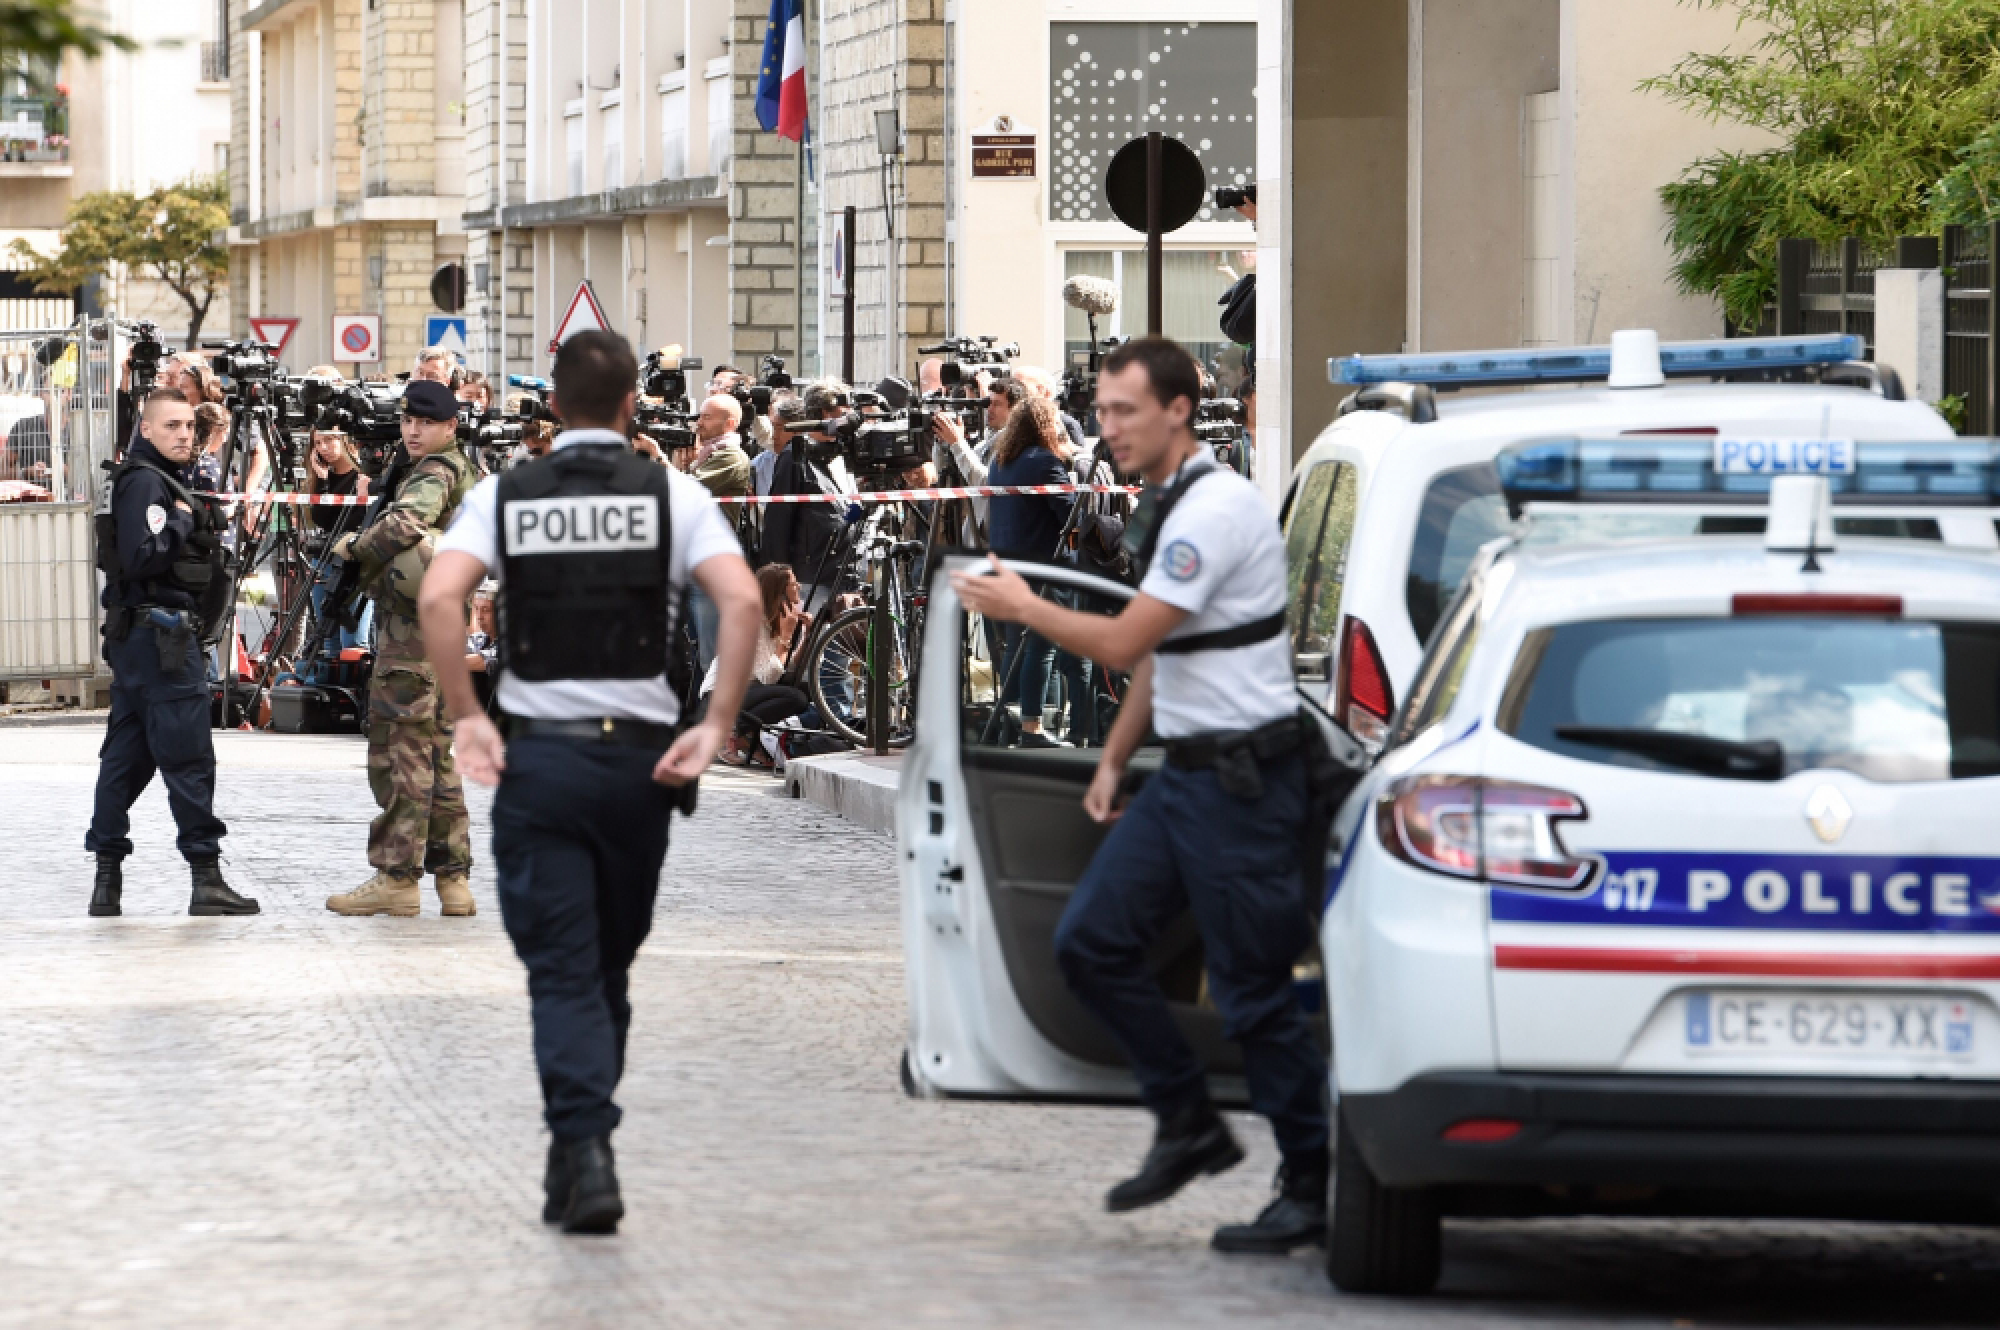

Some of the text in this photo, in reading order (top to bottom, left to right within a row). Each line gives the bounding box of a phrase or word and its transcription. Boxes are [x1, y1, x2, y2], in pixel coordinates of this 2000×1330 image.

[1722, 440, 1848, 471] POLICE
[516, 504, 648, 546] POLICE
[1686, 868, 1971, 915] POLICE
[1718, 1000, 1938, 1048] CE-629-XX
